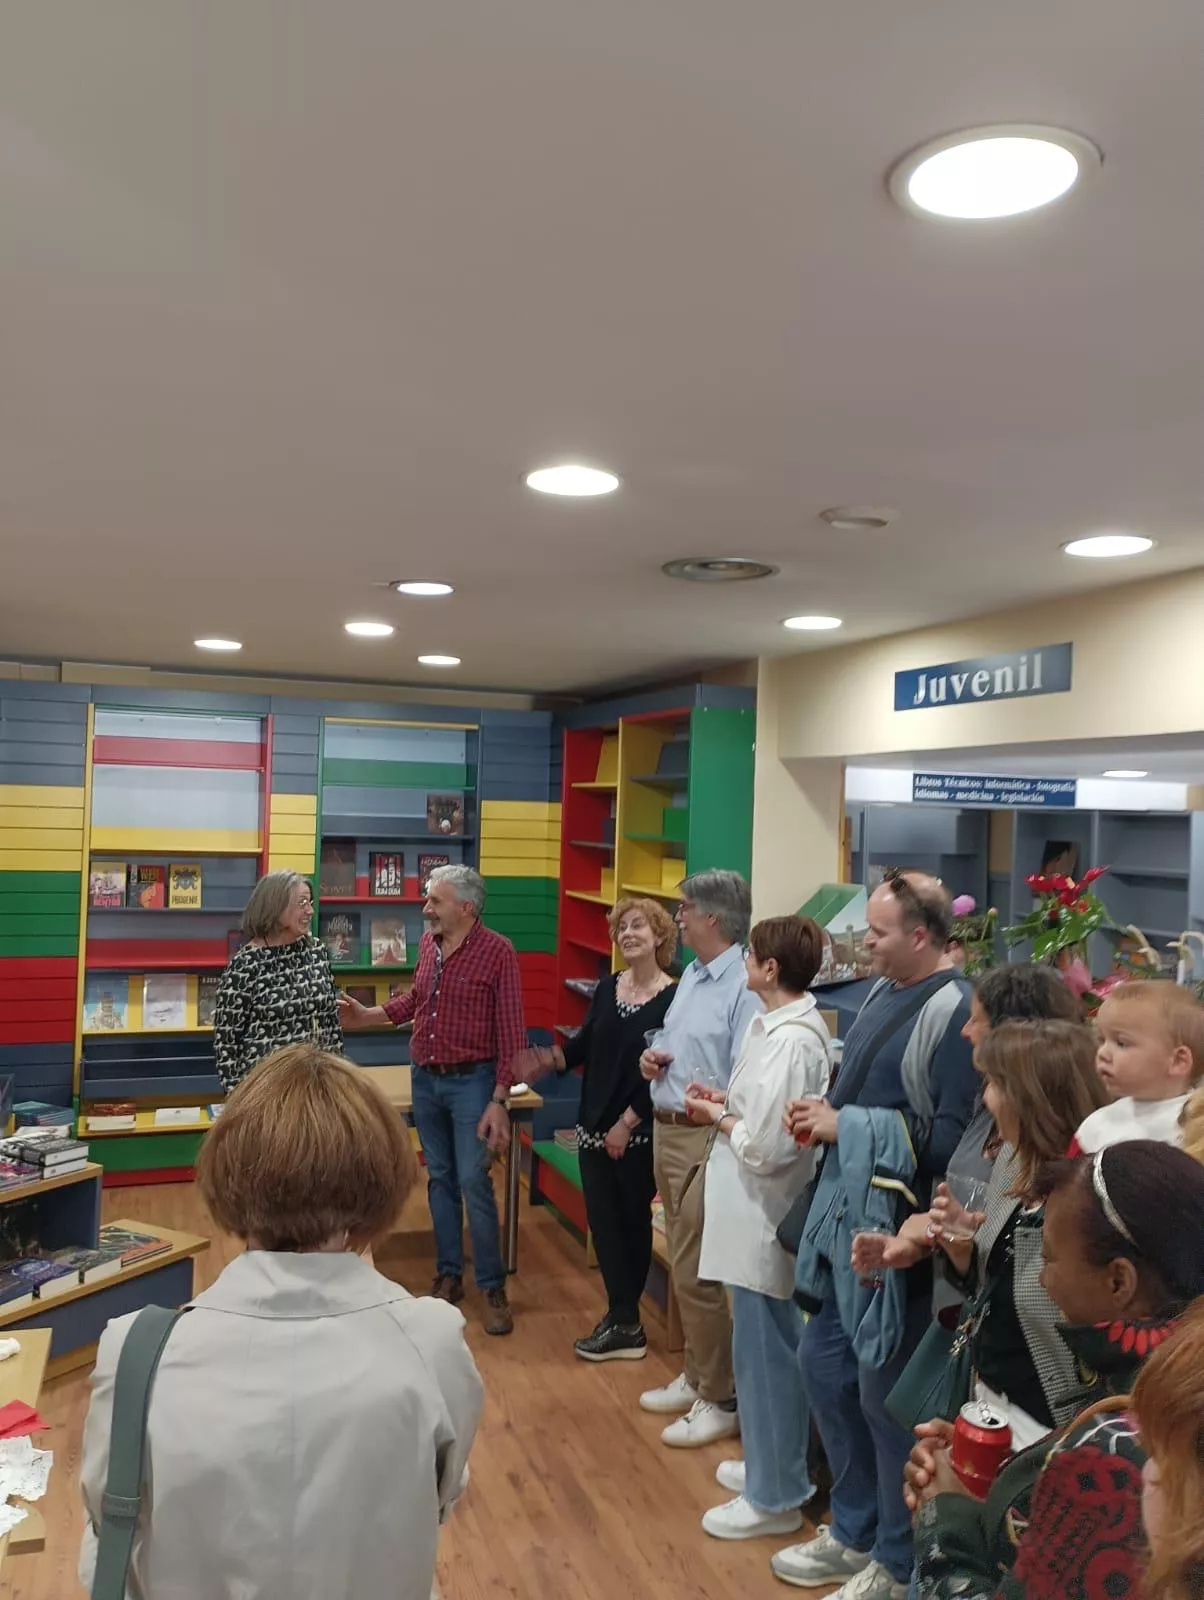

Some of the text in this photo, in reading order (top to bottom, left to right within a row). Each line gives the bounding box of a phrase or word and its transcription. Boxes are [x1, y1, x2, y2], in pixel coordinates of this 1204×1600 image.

[913, 652, 1043, 705] Juvenil
[915, 775, 942, 787] Libros
[955, 791, 994, 802] medicina
